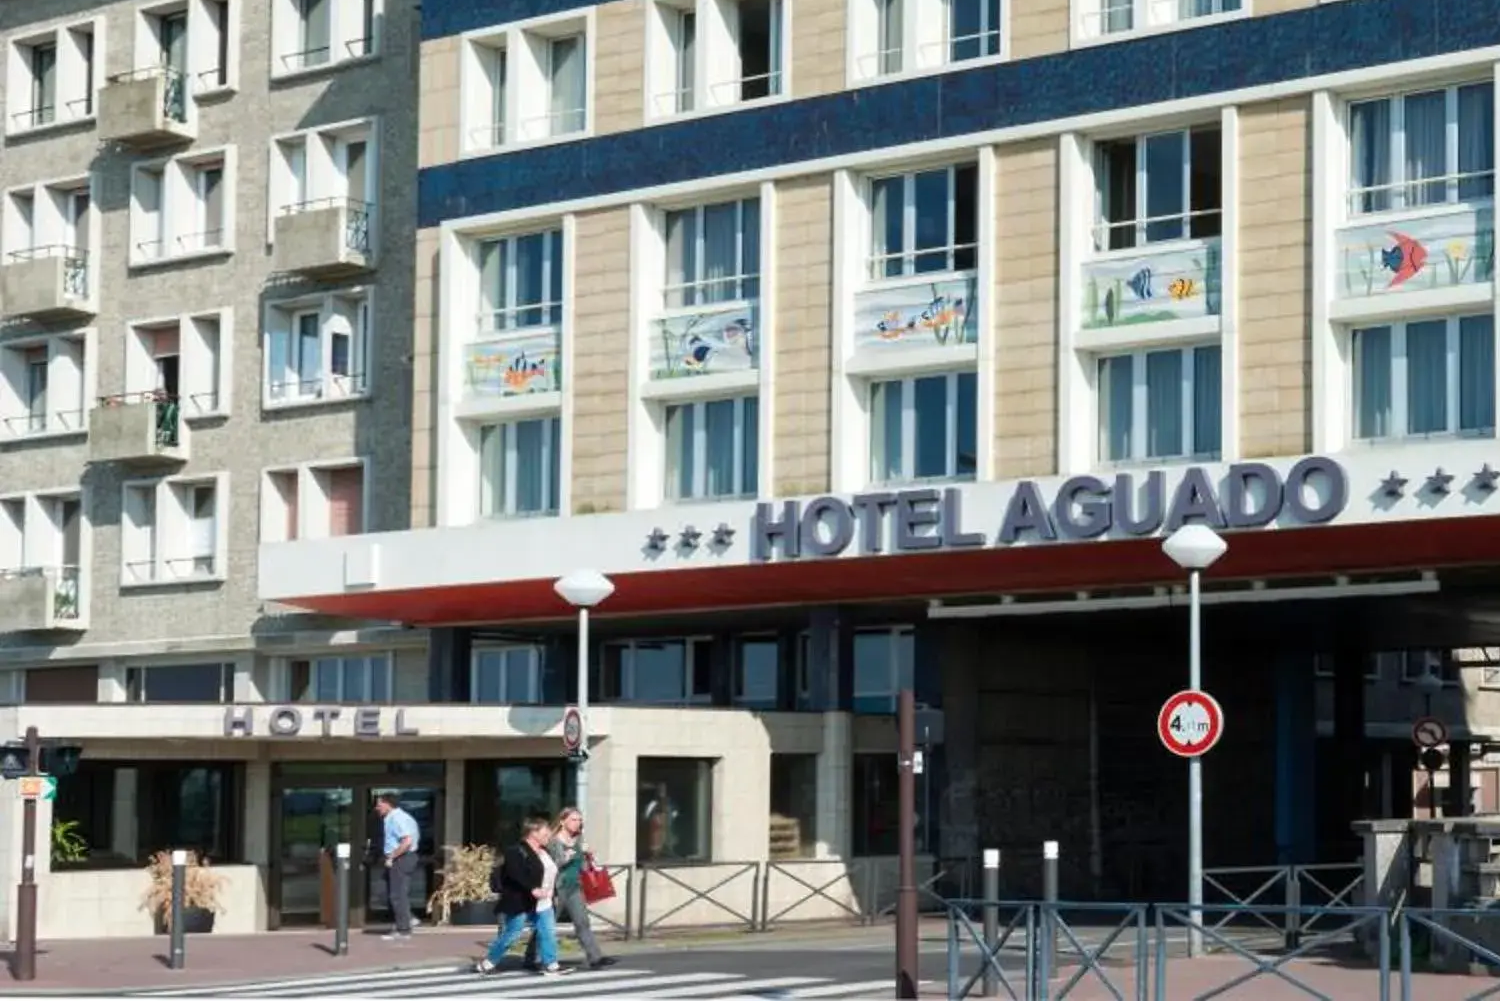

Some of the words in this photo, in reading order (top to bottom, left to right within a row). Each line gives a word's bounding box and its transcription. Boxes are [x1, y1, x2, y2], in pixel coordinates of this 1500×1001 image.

[754, 487, 986, 560] HOTEL
[1000, 456, 1347, 544] AGUADO
[224, 706, 419, 737] HOTEL
